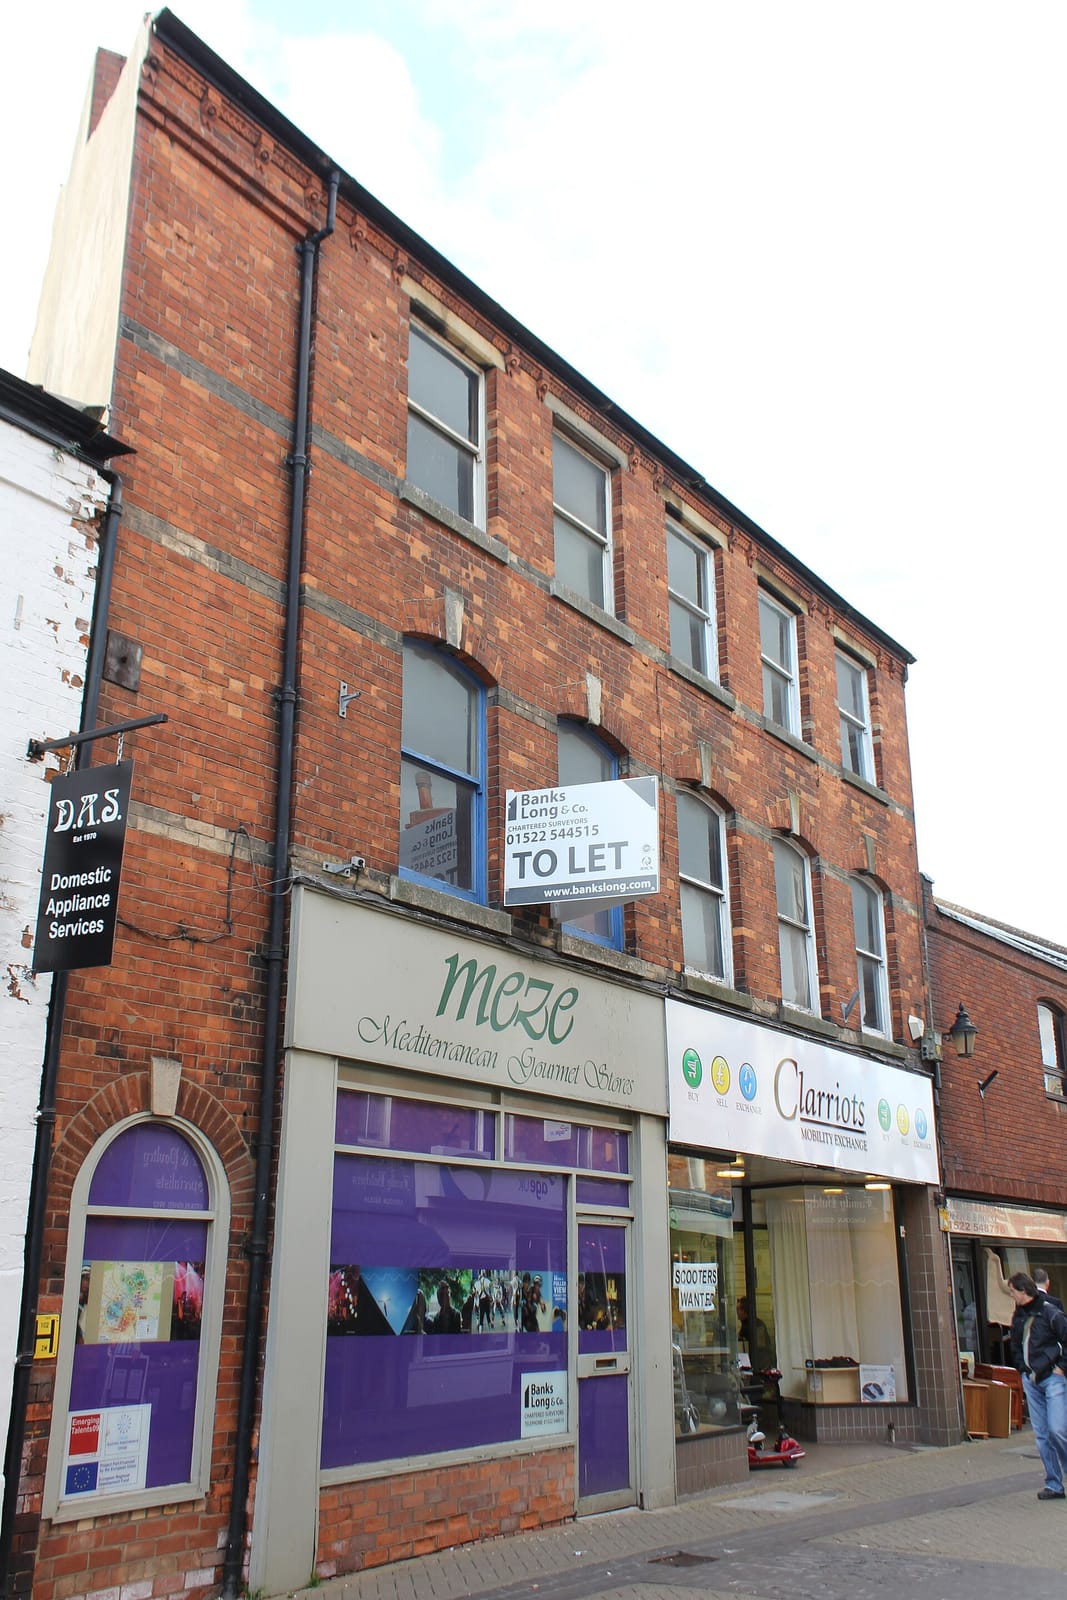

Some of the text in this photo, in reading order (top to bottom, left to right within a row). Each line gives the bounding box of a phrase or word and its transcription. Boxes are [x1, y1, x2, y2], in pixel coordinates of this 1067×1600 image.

[521, 790, 566, 806] Banks
[53, 788, 122, 832] D.A.S.
[521, 803, 589, 819] Long & Co.
[508, 817, 588, 832] CHARTERED SURVEYORS
[73, 832, 97, 843] Est 1970
[506, 824, 599, 845] 01522 544515
[512, 841, 629, 880] TO LET
[51, 866, 112, 891] Domestic
[543, 879, 651, 898] www.bankslong.com
[45, 892, 110, 917] Appliance
[48, 918, 104, 939] Services
[357, 1015, 635, 1096] Mediterranean Gourmet Stores
[687, 1091, 699, 1102] BUY
[773, 1057, 866, 1128] Clarriots
[716, 1097, 728, 1108] SELL
[800, 1126, 834, 1146] MOBILITY
[834, 1133, 868, 1151] EXCHANGE
[675, 1269, 717, 1284] SCOOTERS
[531, 1382, 554, 1395] Banks
[531, 1396, 550, 1409] Long
